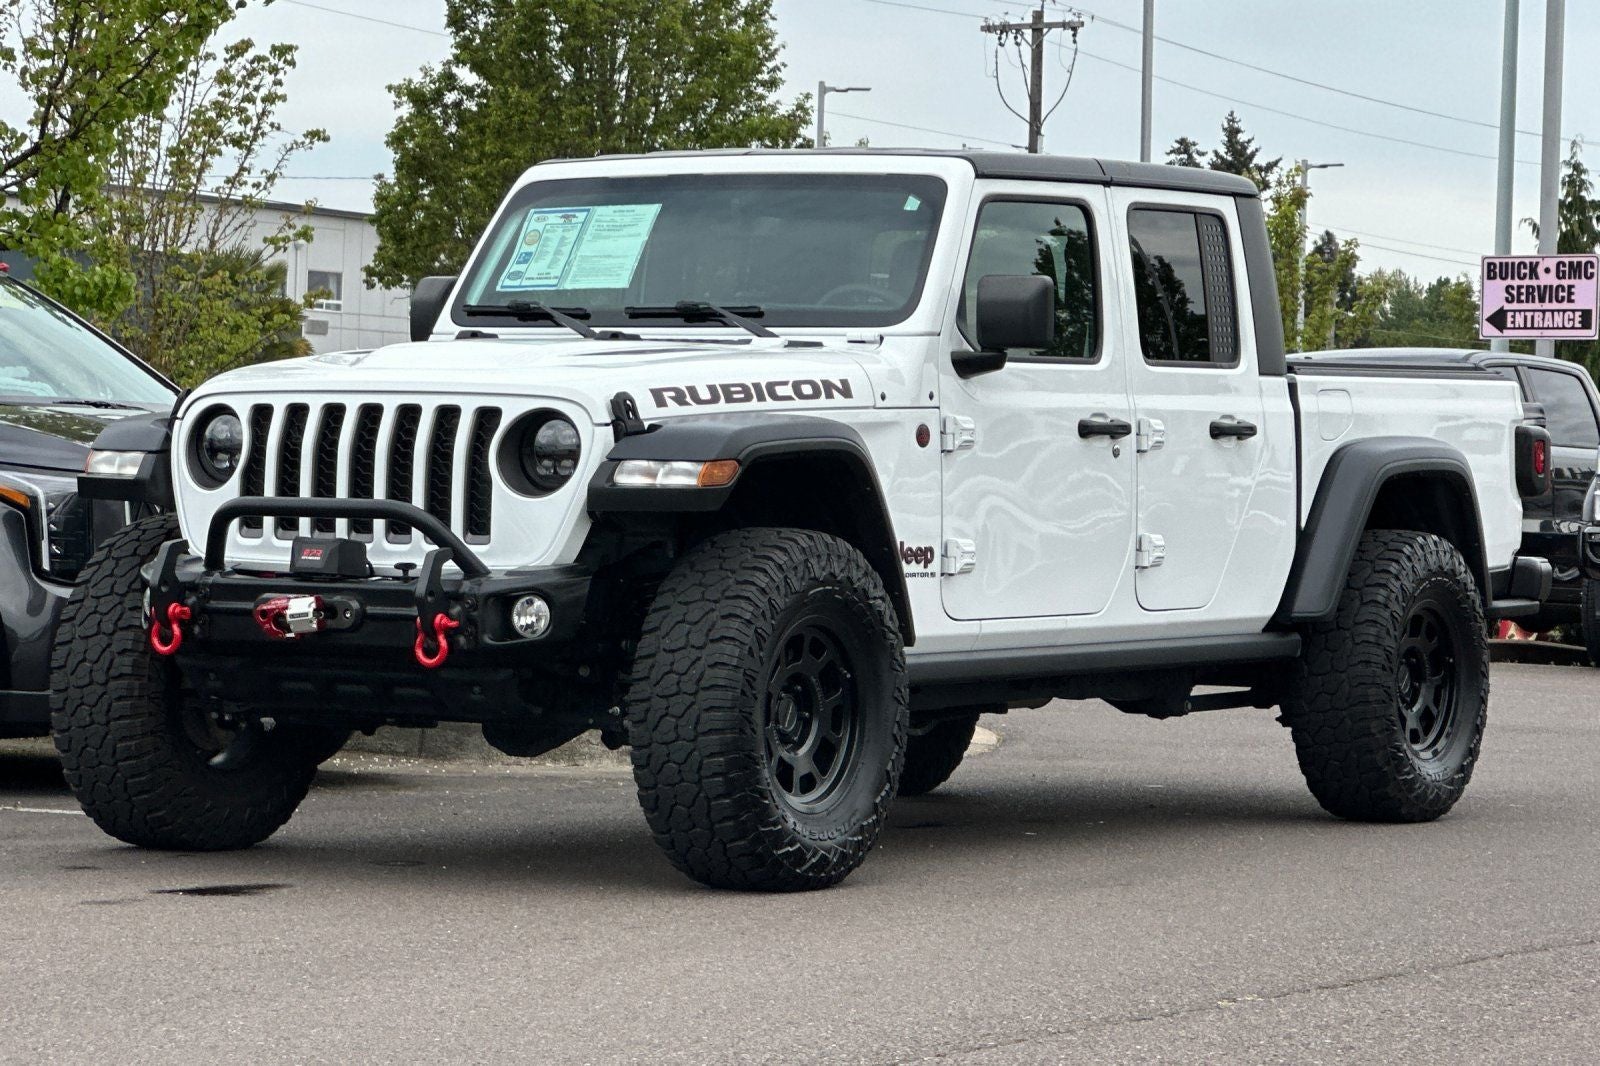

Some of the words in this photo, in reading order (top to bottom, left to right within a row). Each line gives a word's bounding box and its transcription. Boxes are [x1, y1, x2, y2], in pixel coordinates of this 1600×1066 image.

[1486, 261, 1540, 281] BUICK
[1555, 260, 1595, 280] GMC
[1504, 284, 1575, 304] SERVICE
[1506, 311, 1582, 328] ENTRANCE
[648, 378, 854, 408] RUBICON
